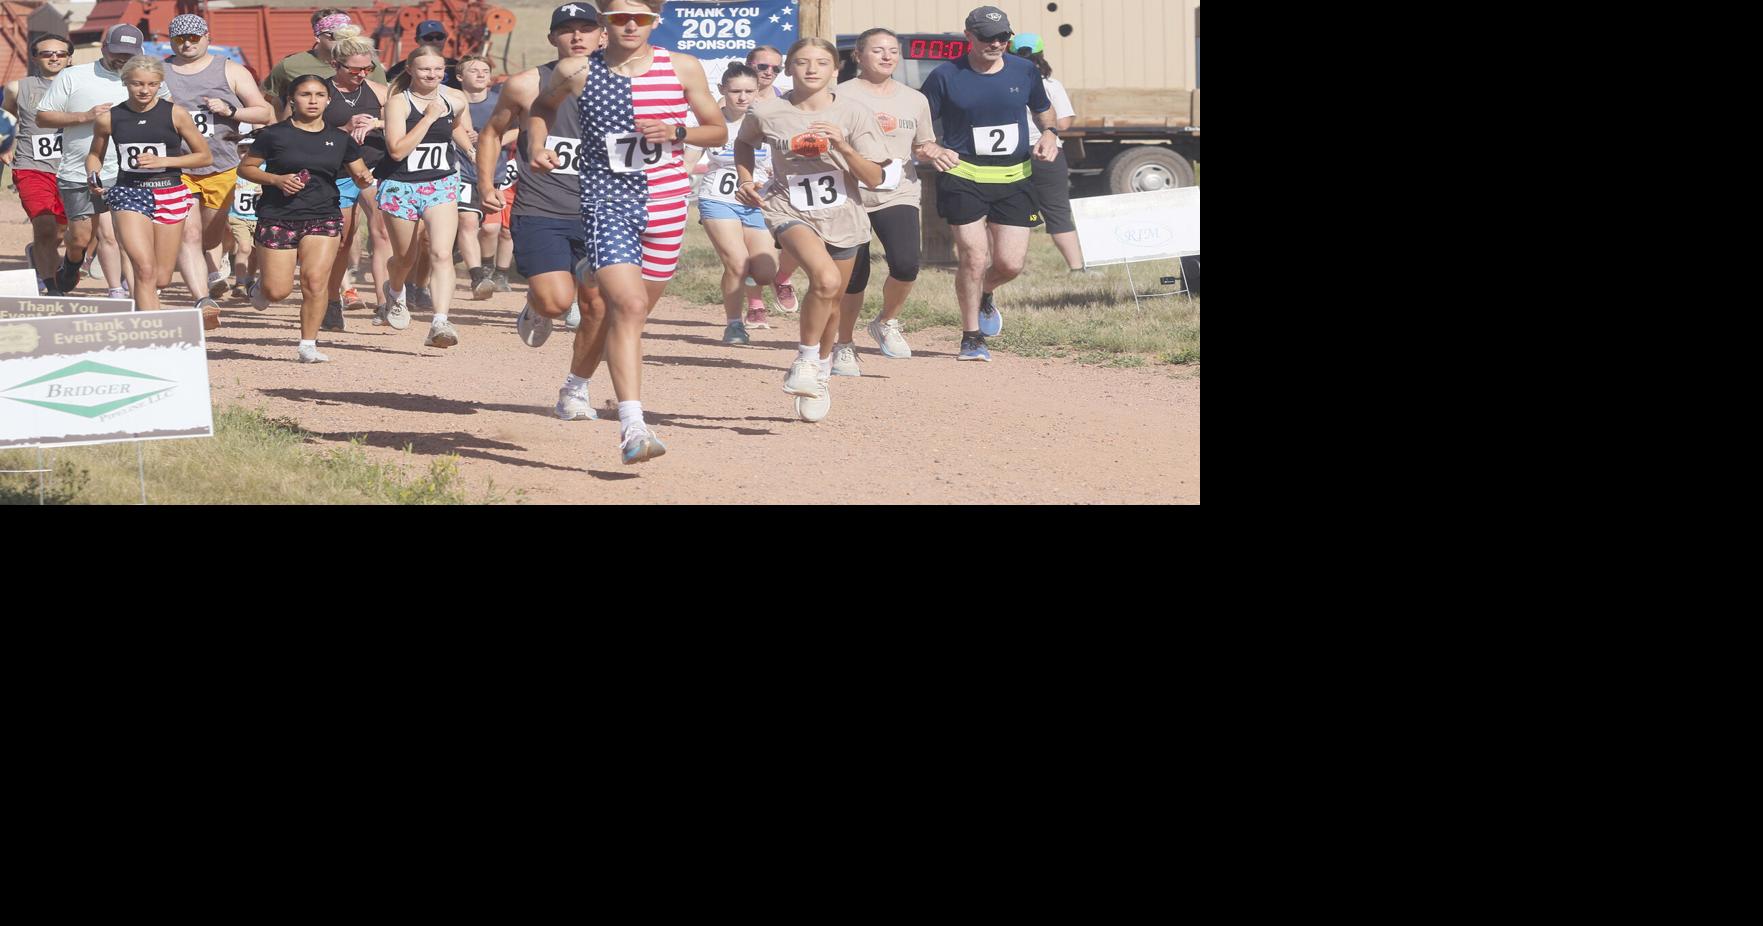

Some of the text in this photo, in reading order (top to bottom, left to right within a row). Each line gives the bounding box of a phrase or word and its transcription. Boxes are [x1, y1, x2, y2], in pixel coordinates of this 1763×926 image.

[675, 8, 759, 18] THANK YOU
[682, 19, 751, 38] 2026
[677, 40, 756, 50] SPONSORS
[38, 136, 63, 157] 84
[989, 129, 1007, 153] 2
[416, 146, 442, 169] 70
[616, 136, 663, 168] 79
[719, 172, 739, 196] 6
[798, 175, 838, 207] 13
[18, 300, 99, 314] Thank You
[73, 317, 163, 333] Thank You
[54, 330, 101, 345] Event
[107, 327, 183, 344] Sponsor!
[46, 383, 131, 398] BRIDGER
